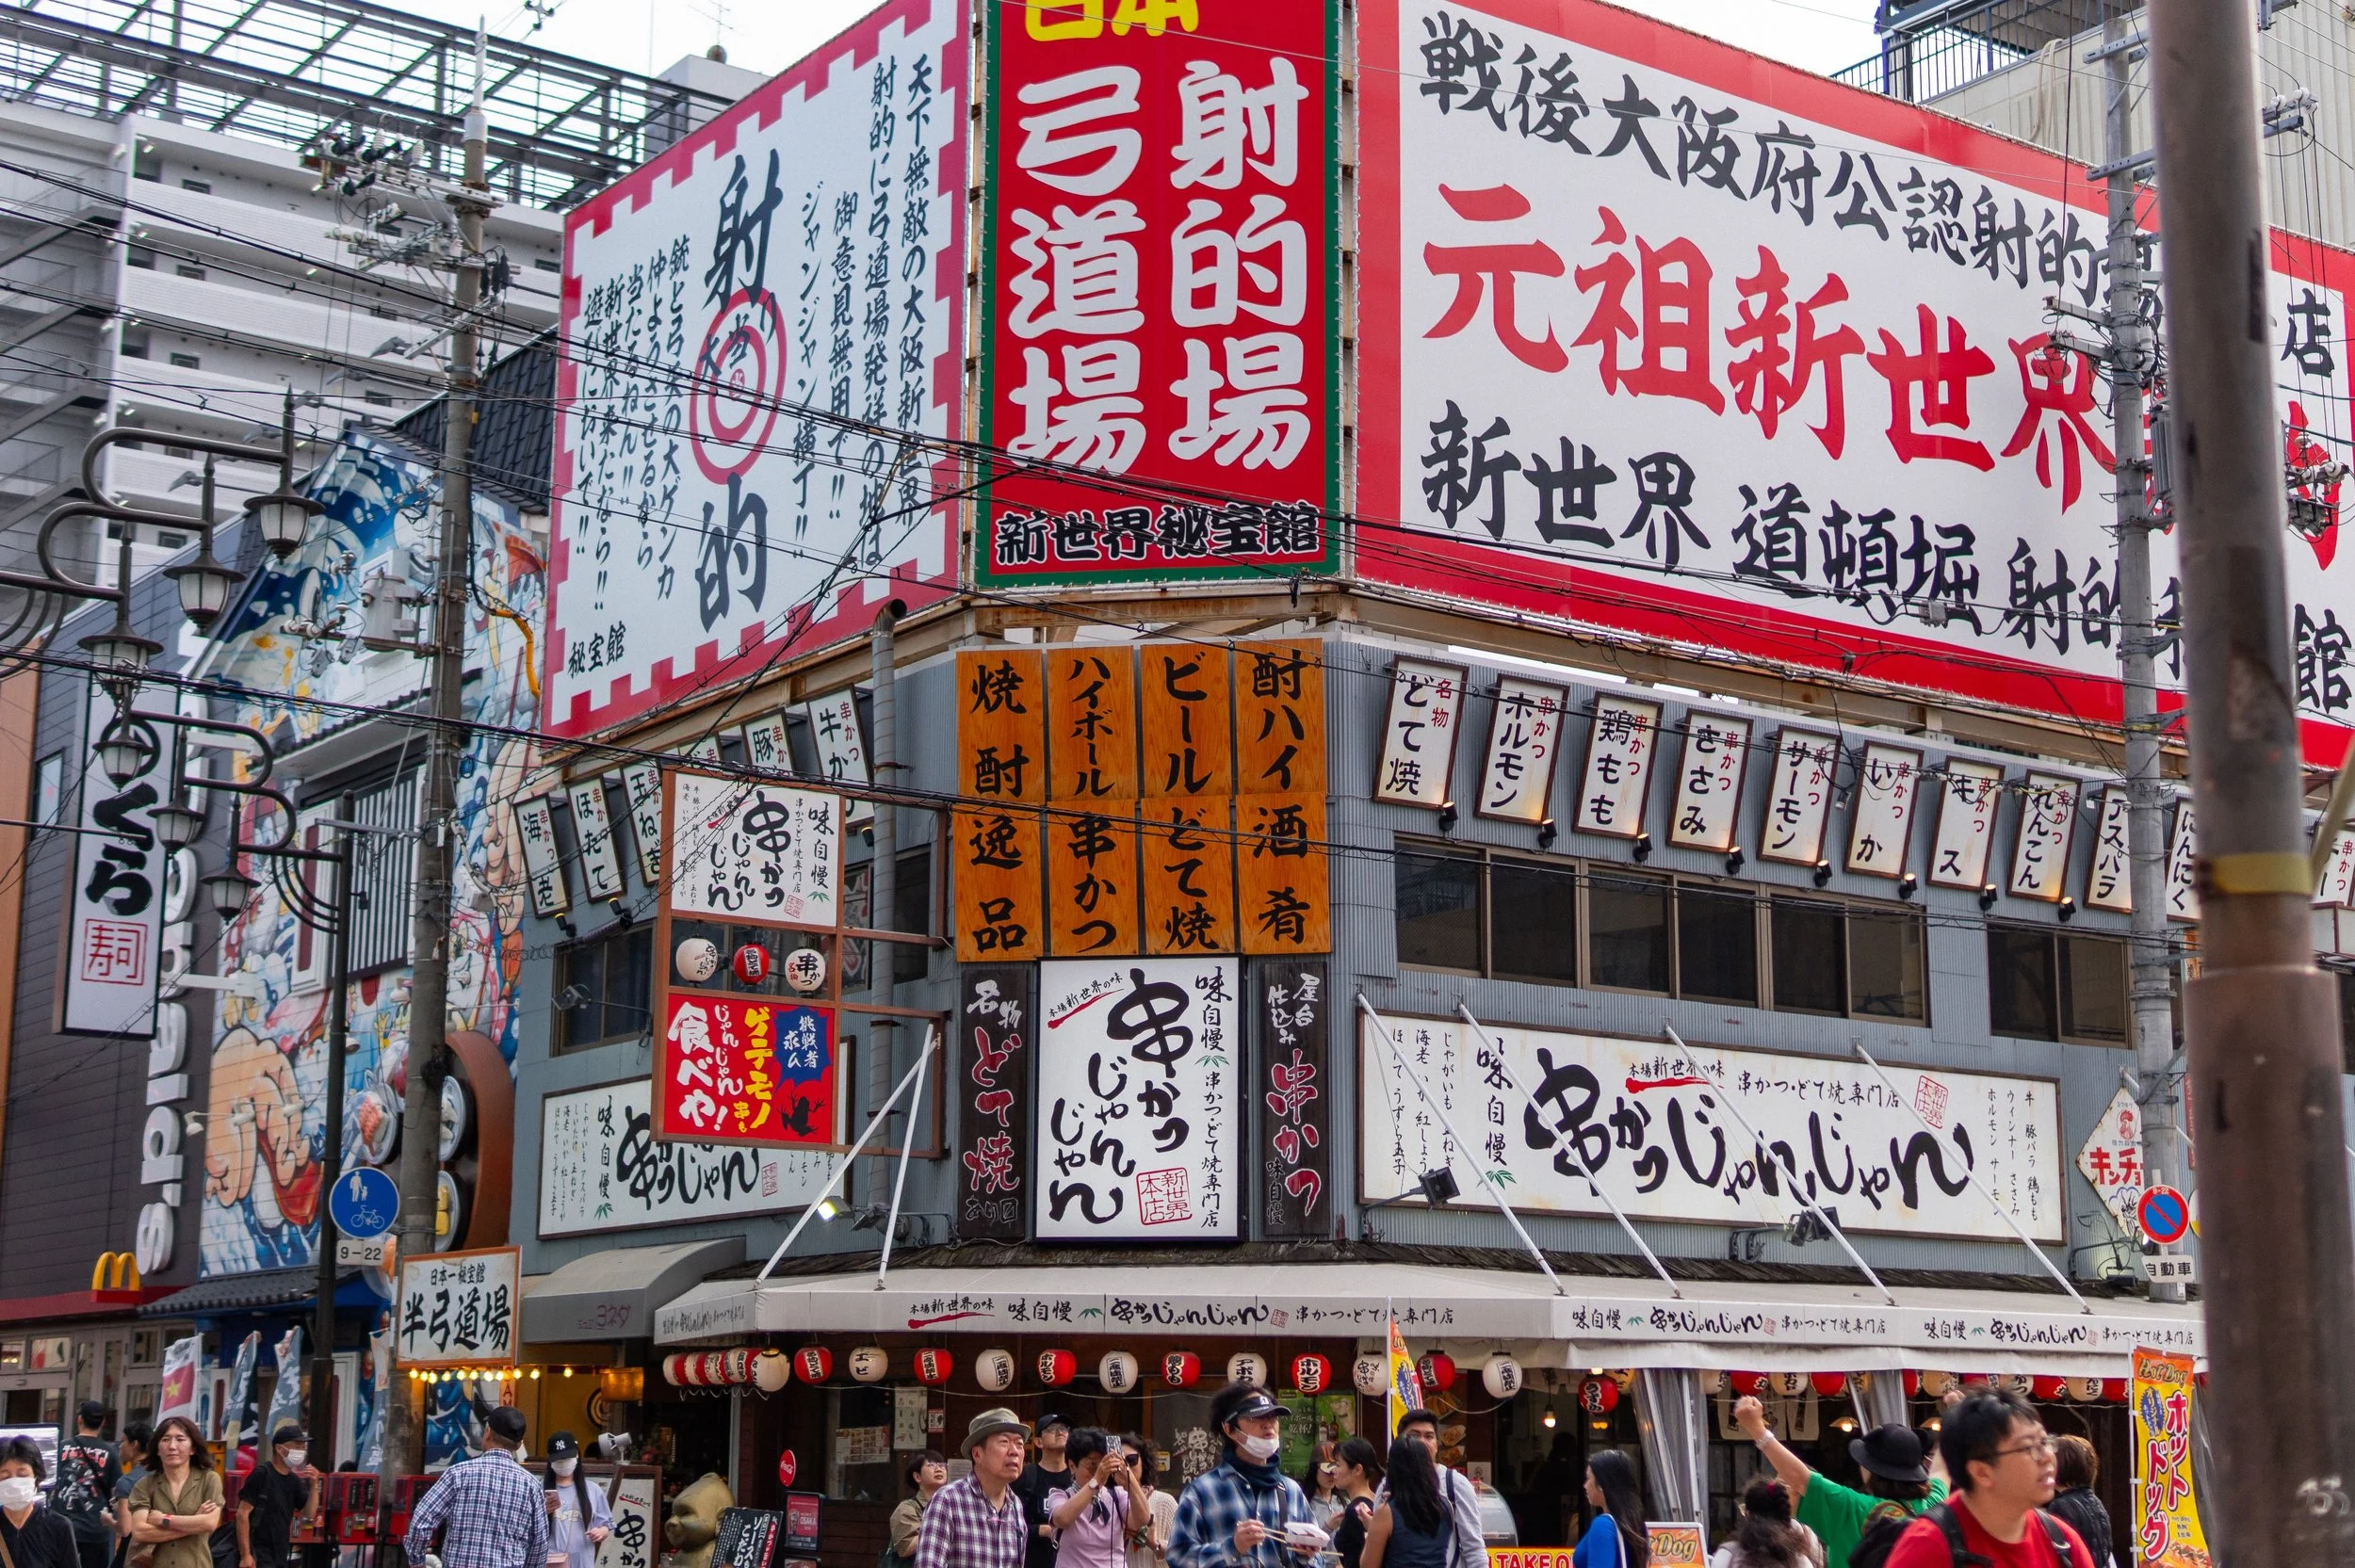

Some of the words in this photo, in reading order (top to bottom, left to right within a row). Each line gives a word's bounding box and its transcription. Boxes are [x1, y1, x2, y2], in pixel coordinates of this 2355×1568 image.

[895, 54, 932, 528] 天下無敵の大阪新世界
[1008, 65, 1146, 477] 弓道場
[1168, 57, 1310, 470] 射的場
[860, 55, 897, 569] 射的に弓道場発祥の地は
[637, 249, 667, 570] 仲ようさせるから
[658, 234, 690, 600] 銃と弓矢の大ゲンカ
[695, 148, 783, 634] 射的
[996, 499, 1321, 565] 新世界秘宝館
[1421, 399, 1713, 577] 新世界
[1730, 481, 1983, 638] 道頓堀
[568, 621, 625, 678] 秘宝館
[840, 701, 859, 763] 串かつ
[970, 659, 1029, 799] 焼酎
[1067, 656, 1115, 796] ハイボール
[1164, 651, 1212, 795] ビール
[1251, 649, 1309, 790] 酎ハイ
[1386, 673, 1434, 796] どて焼
[1432, 678, 1452, 728] 名物
[1531, 695, 1553, 759] 串かつ
[1490, 691, 1533, 808] ホルモン
[1590, 709, 1633, 825] 鶏もも
[1628, 715, 1648, 776] 串かつ
[1680, 723, 1721, 835] ささみ
[1718, 731, 1738, 791] 串かつ
[1809, 746, 1827, 805] 串かつ
[1772, 740, 1811, 849] サーモン
[1856, 757, 1892, 862] いか
[1892, 761, 1910, 818] 串かつ
[1973, 776, 1990, 832] 串かつ
[2052, 790, 2070, 845] 串かつ
[86, 783, 158, 916] くら
[523, 812, 557, 908] 海老
[539, 809, 556, 861] 串かつ
[575, 790, 609, 890] ほたて
[743, 790, 791, 908] 串かつ
[808, 800, 835, 889] 味自慢
[1940, 774, 1975, 877] キス
[2018, 784, 2054, 889] れんこん
[707, 842, 744, 911] じゃん
[732, 832, 755, 897] じゃん
[970, 814, 1028, 953] 逸品
[1067, 812, 1117, 953] 串かつ
[1164, 806, 1220, 950] どて焼
[1252, 804, 1310, 944] 酒肴
[2337, 840, 2353, 891] 串かつ
[87, 923, 142, 979] 寿司
[796, 952, 820, 986] 串かつ
[966, 979, 1022, 1029] 名物
[1048, 973, 1124, 1018] 本場新世界の味
[1194, 965, 1232, 1053] 味自慢
[1267, 986, 1297, 1045] 仕込み
[1293, 973, 1320, 1027] 屋台
[744, 1006, 773, 1129] ゲテモノ
[784, 1030, 801, 1068] 求ム
[800, 1015, 819, 1068] 挑戦者
[1107, 968, 1194, 1153] 串かつ
[1416, 1028, 1430, 1064] 海老
[1442, 1032, 1454, 1109] じゃがいも
[734, 1101, 750, 1133] 串も
[963, 1026, 1022, 1194] どて焼
[1088, 1052, 1136, 1177] じゃん
[1266, 1049, 1321, 1217] 串かつ
[1477, 1037, 1513, 1167] 味自慢
[1524, 1047, 1973, 1210] 串かつじゃんじゃん
[2025, 1091, 2034, 1107] 牛
[597, 1094, 615, 1200] 味自慢
[1048, 1097, 1124, 1224] じゃん
[2025, 1124, 2037, 1168] 豚バラ
[1140, 1174, 1162, 1222] 本店
[1161, 1170, 1192, 1222] 新世界
[1266, 1159, 1286, 1225] 味自慢
[2010, 1173, 2020, 1216] ささみ
[2145, 1261, 2192, 1277] 自動車
[401, 1284, 512, 1353] 半弓道場
[910, 1299, 995, 1316] 本場新世界の味
[1008, 1299, 1072, 1322] 味自慢
[1111, 1298, 1269, 1326] 串かつじゃんじゃん
[1572, 1306, 1621, 1330] 味自慢
[1924, 1316, 1967, 1340] 味自慢
[854, 1352, 869, 1376] エビ
[1040, 1353, 1056, 1382] ホルモン
[1299, 1358, 1321, 1392] ホルモン
[2166, 1364, 2187, 1387] Dog
[2166, 1390, 2188, 1511] ホット
[2141, 1440, 2169, 1560] ドッグ
[1658, 1533, 1697, 1561] Dog
